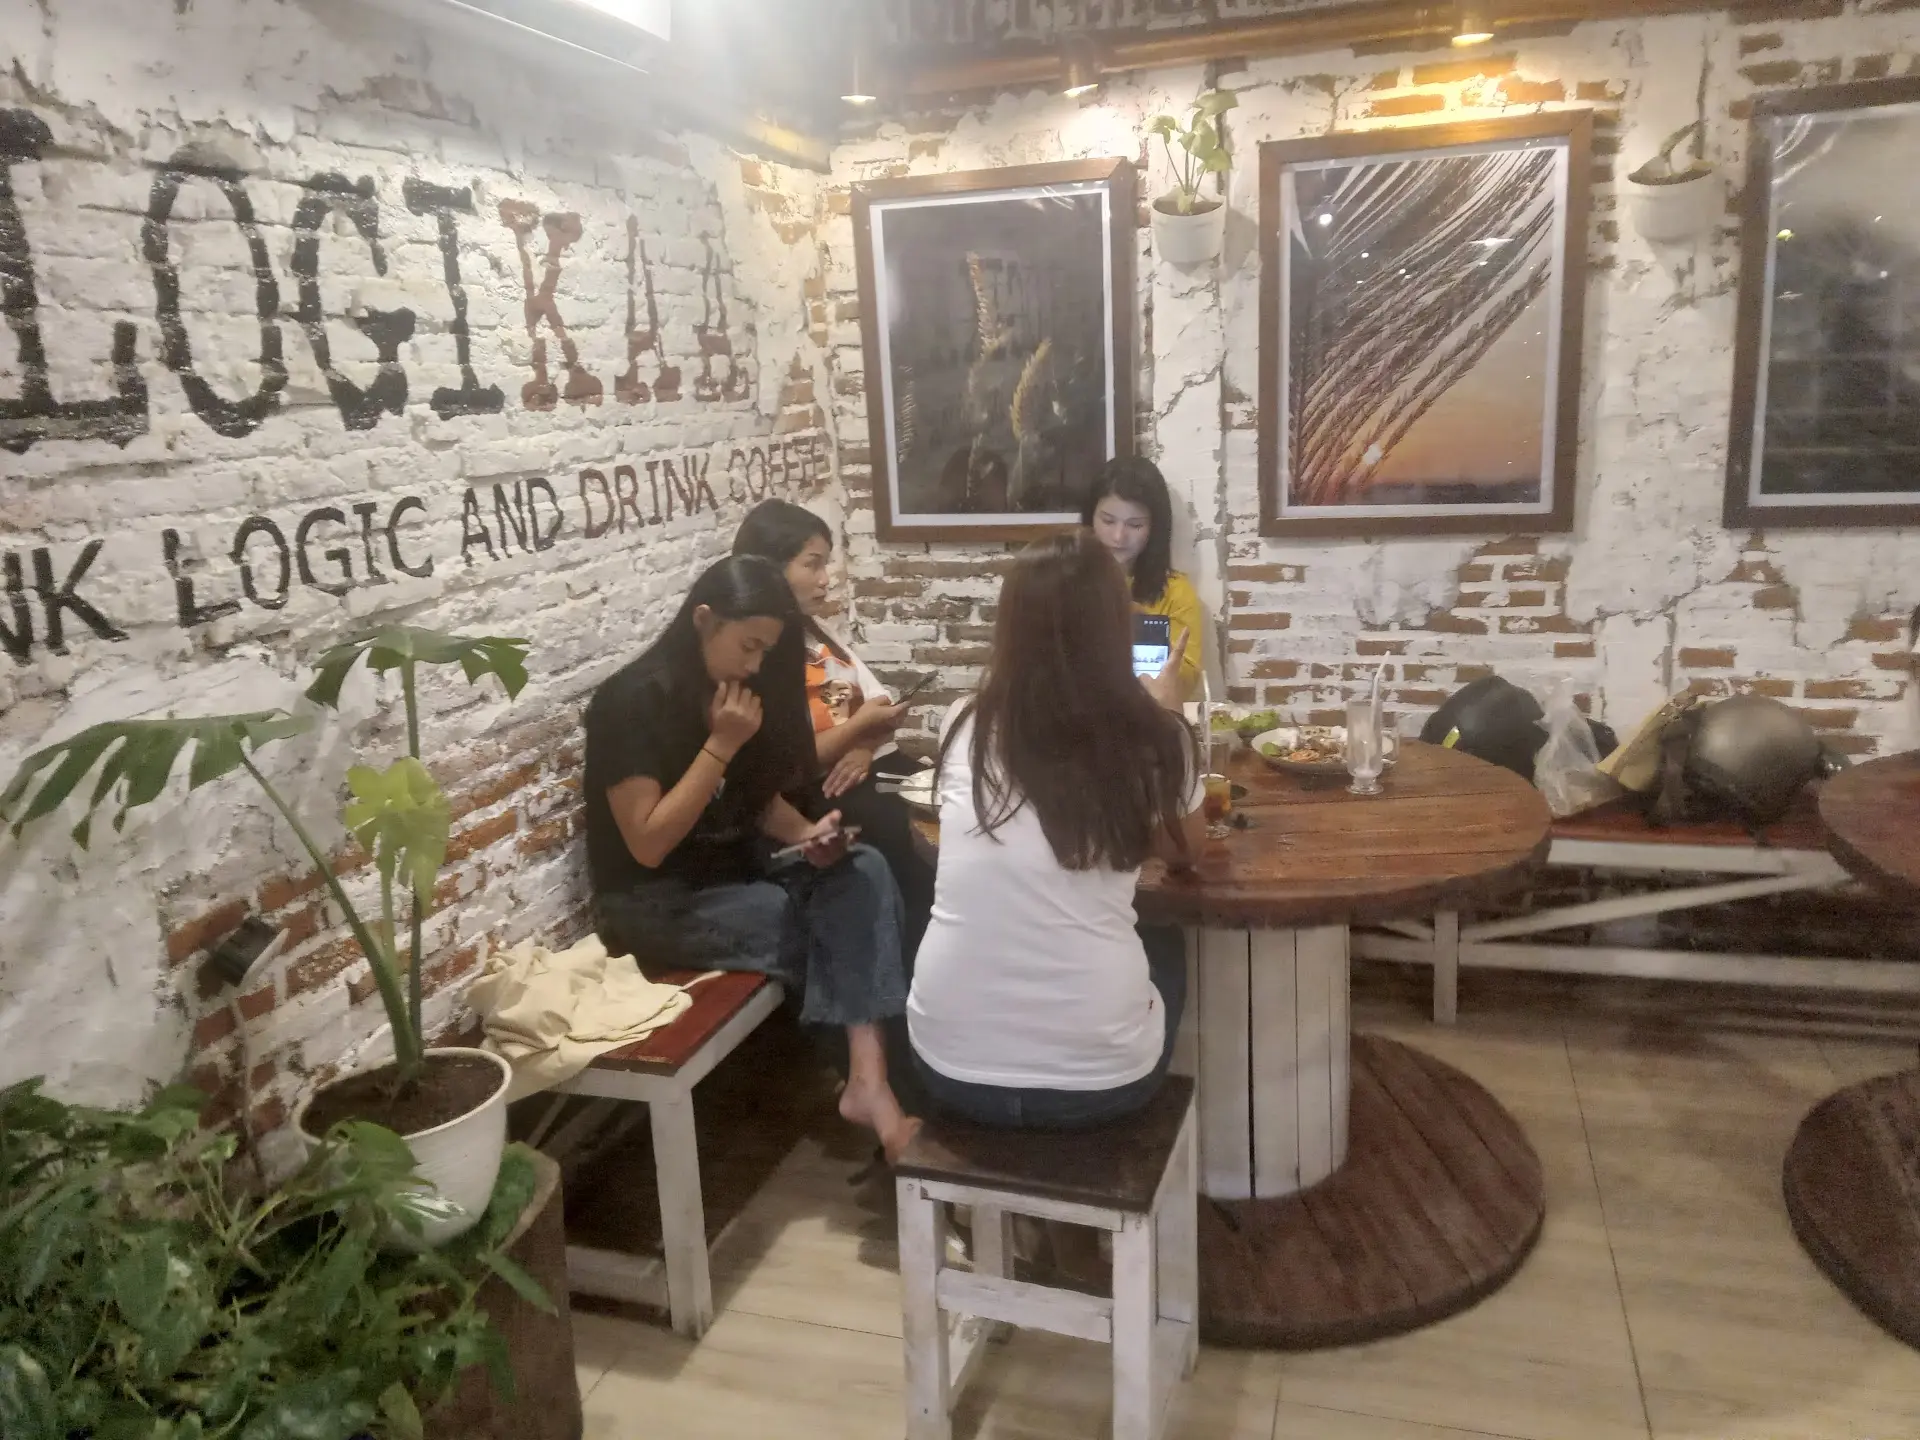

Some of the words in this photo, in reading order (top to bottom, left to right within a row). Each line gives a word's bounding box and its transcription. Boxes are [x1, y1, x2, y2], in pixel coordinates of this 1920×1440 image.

[162, 496, 434, 628] LOGIC
[461, 477, 564, 567] AND
[579, 452, 718, 539] DRINK
[727, 436, 828, 503] COFFEE
